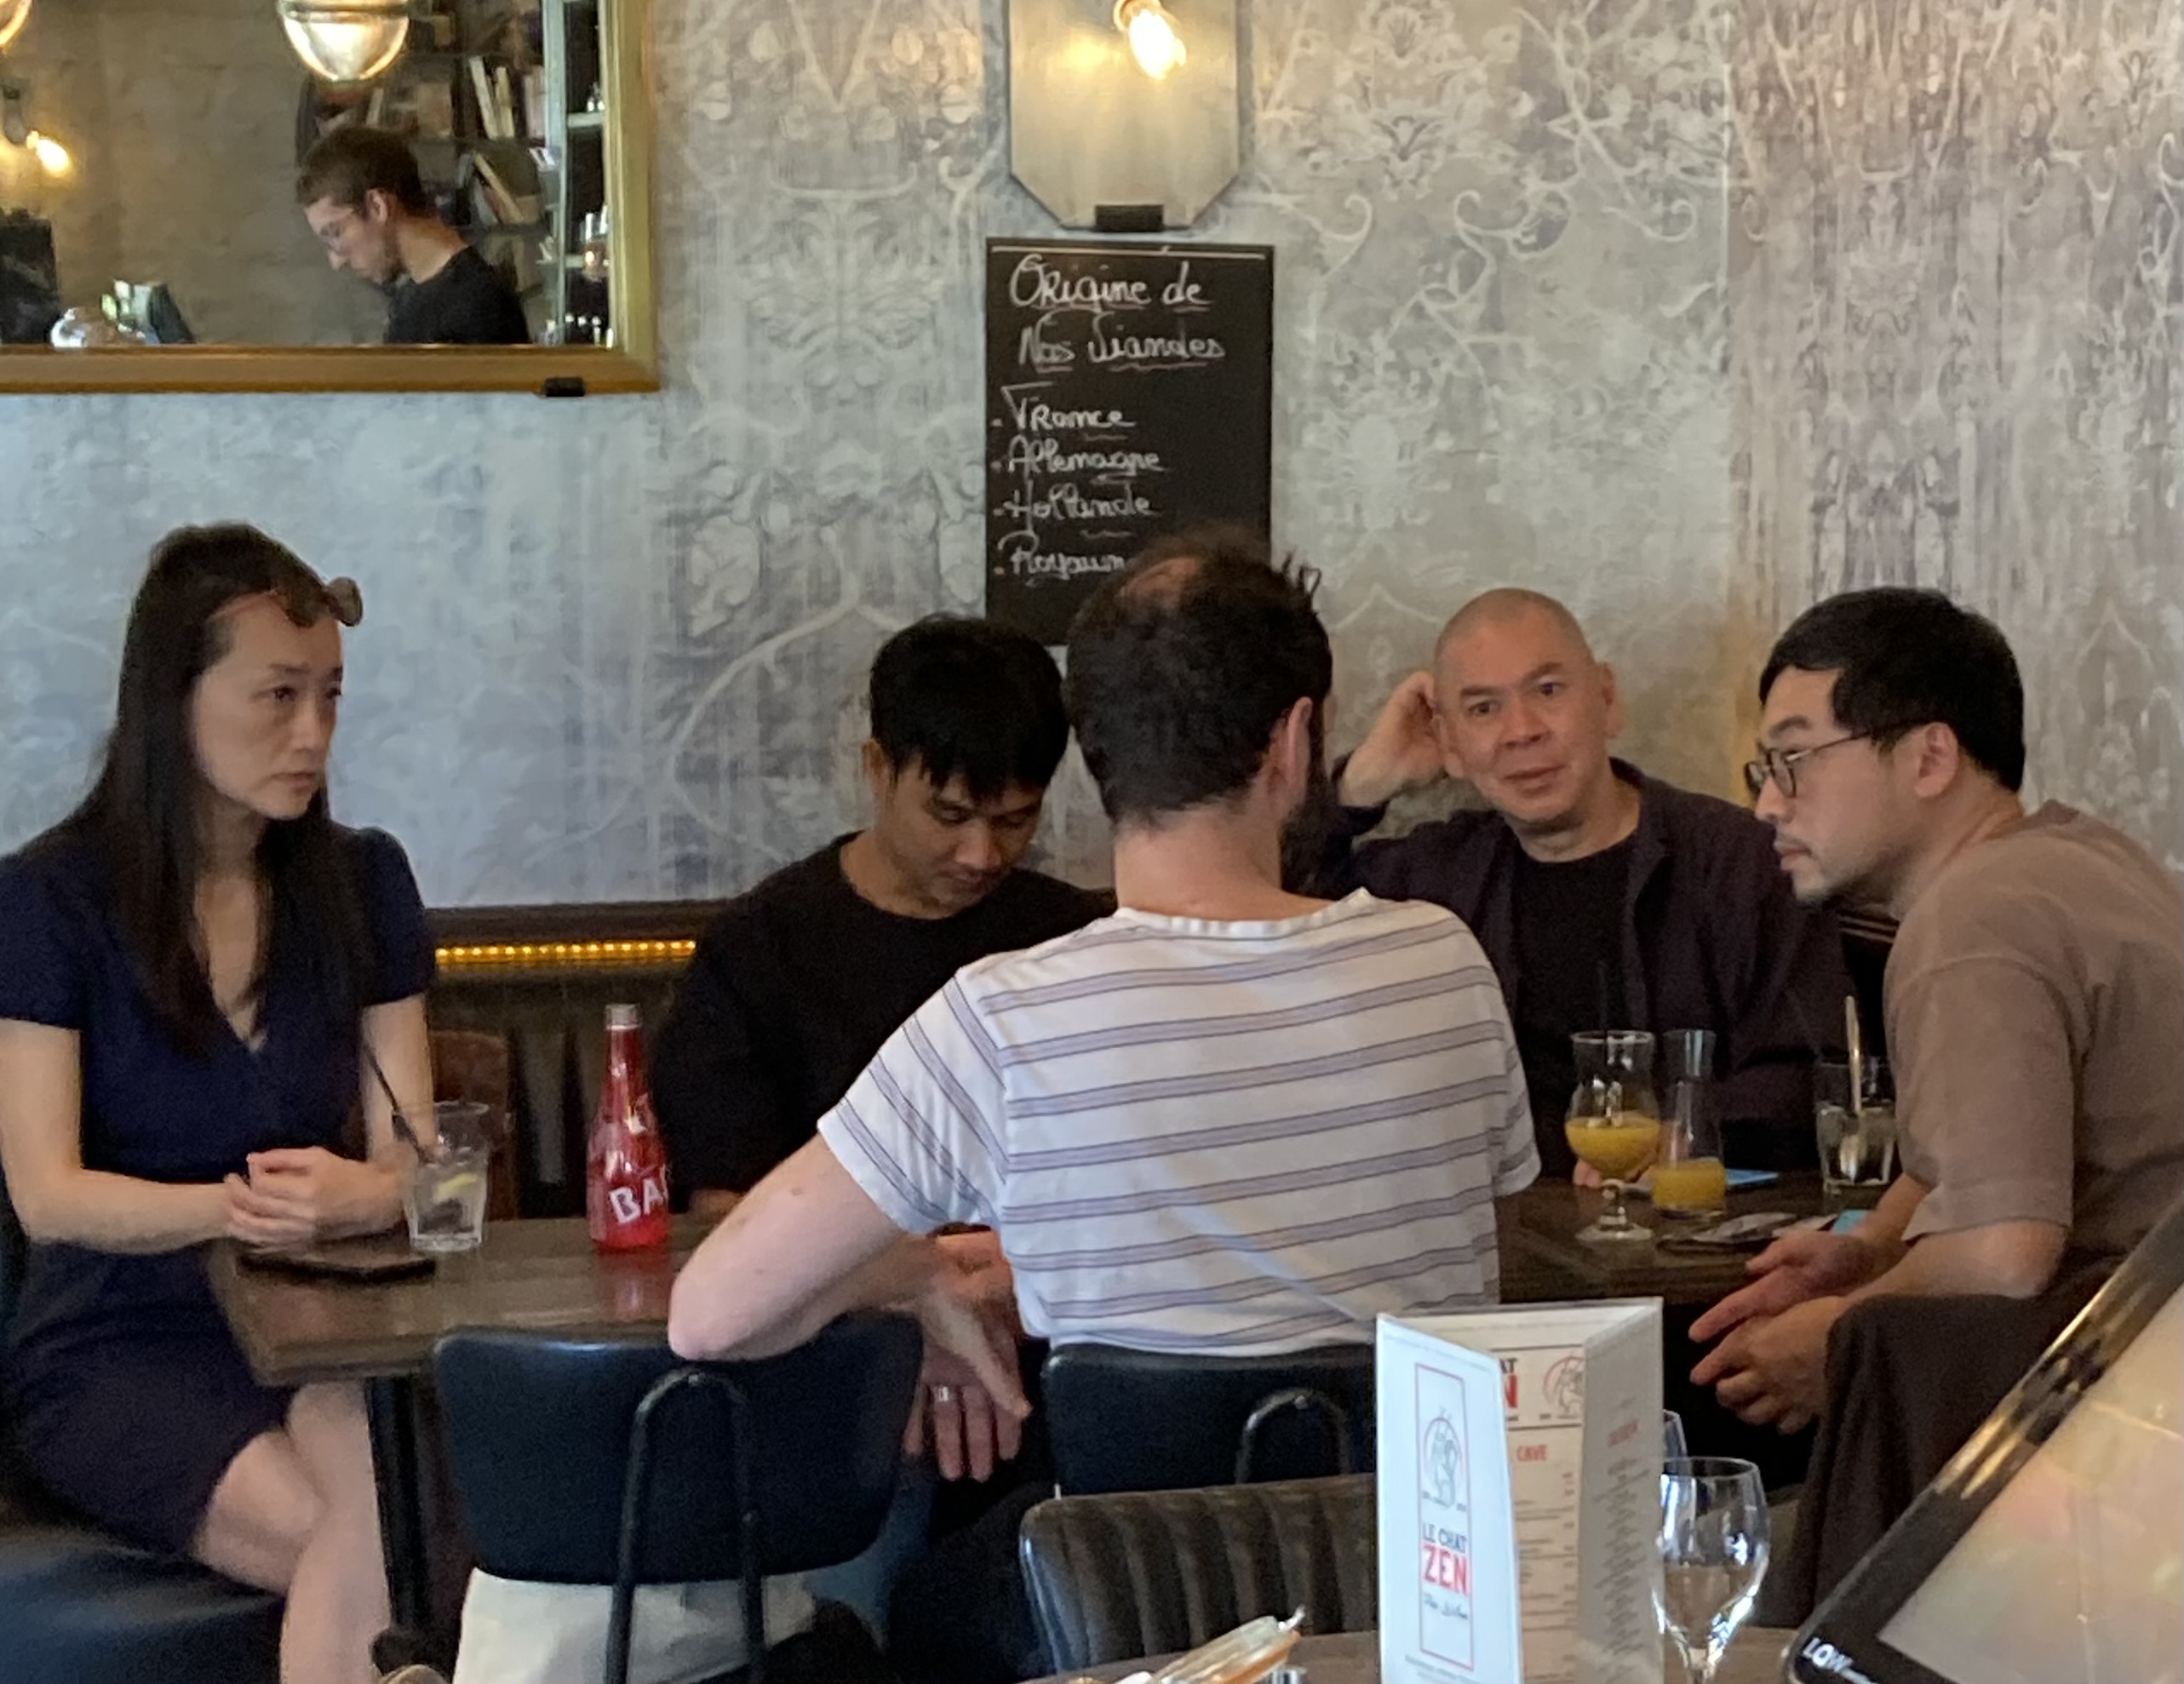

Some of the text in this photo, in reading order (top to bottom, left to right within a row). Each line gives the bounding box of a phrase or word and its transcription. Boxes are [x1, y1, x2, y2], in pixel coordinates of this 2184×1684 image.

[1161, 261, 1212, 306] de
[1017, 318, 1076, 364] Nos
[1008, 434, 1166, 477] Allemagne
[1003, 480, 1155, 520] Hollande
[998, 530, 1126, 581] Royaum
[608, 1177, 666, 1224] BA
[1422, 1521, 1468, 1554] LE CHAT
[1422, 1542, 1470, 1598] ZEN
